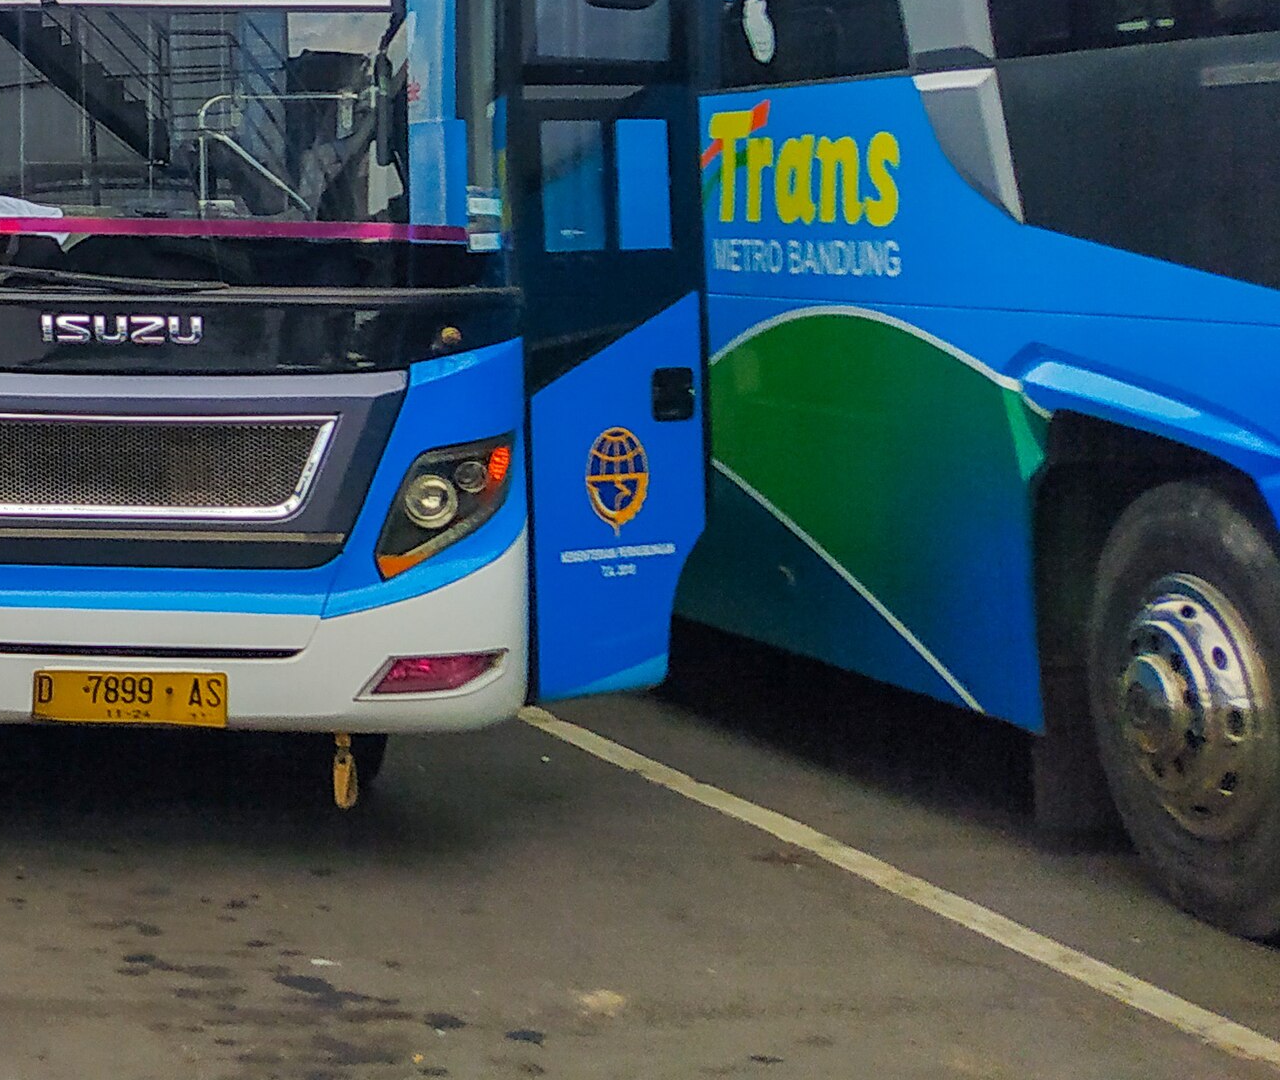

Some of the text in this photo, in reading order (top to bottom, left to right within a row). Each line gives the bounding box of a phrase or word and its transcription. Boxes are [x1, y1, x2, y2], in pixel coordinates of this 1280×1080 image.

[708, 109, 902, 228] Trans
[712, 238, 903, 277] METRO BANDUNG
[40, 314, 204, 344] ISUZU
[37, 674, 223, 708] D 7899 AS
